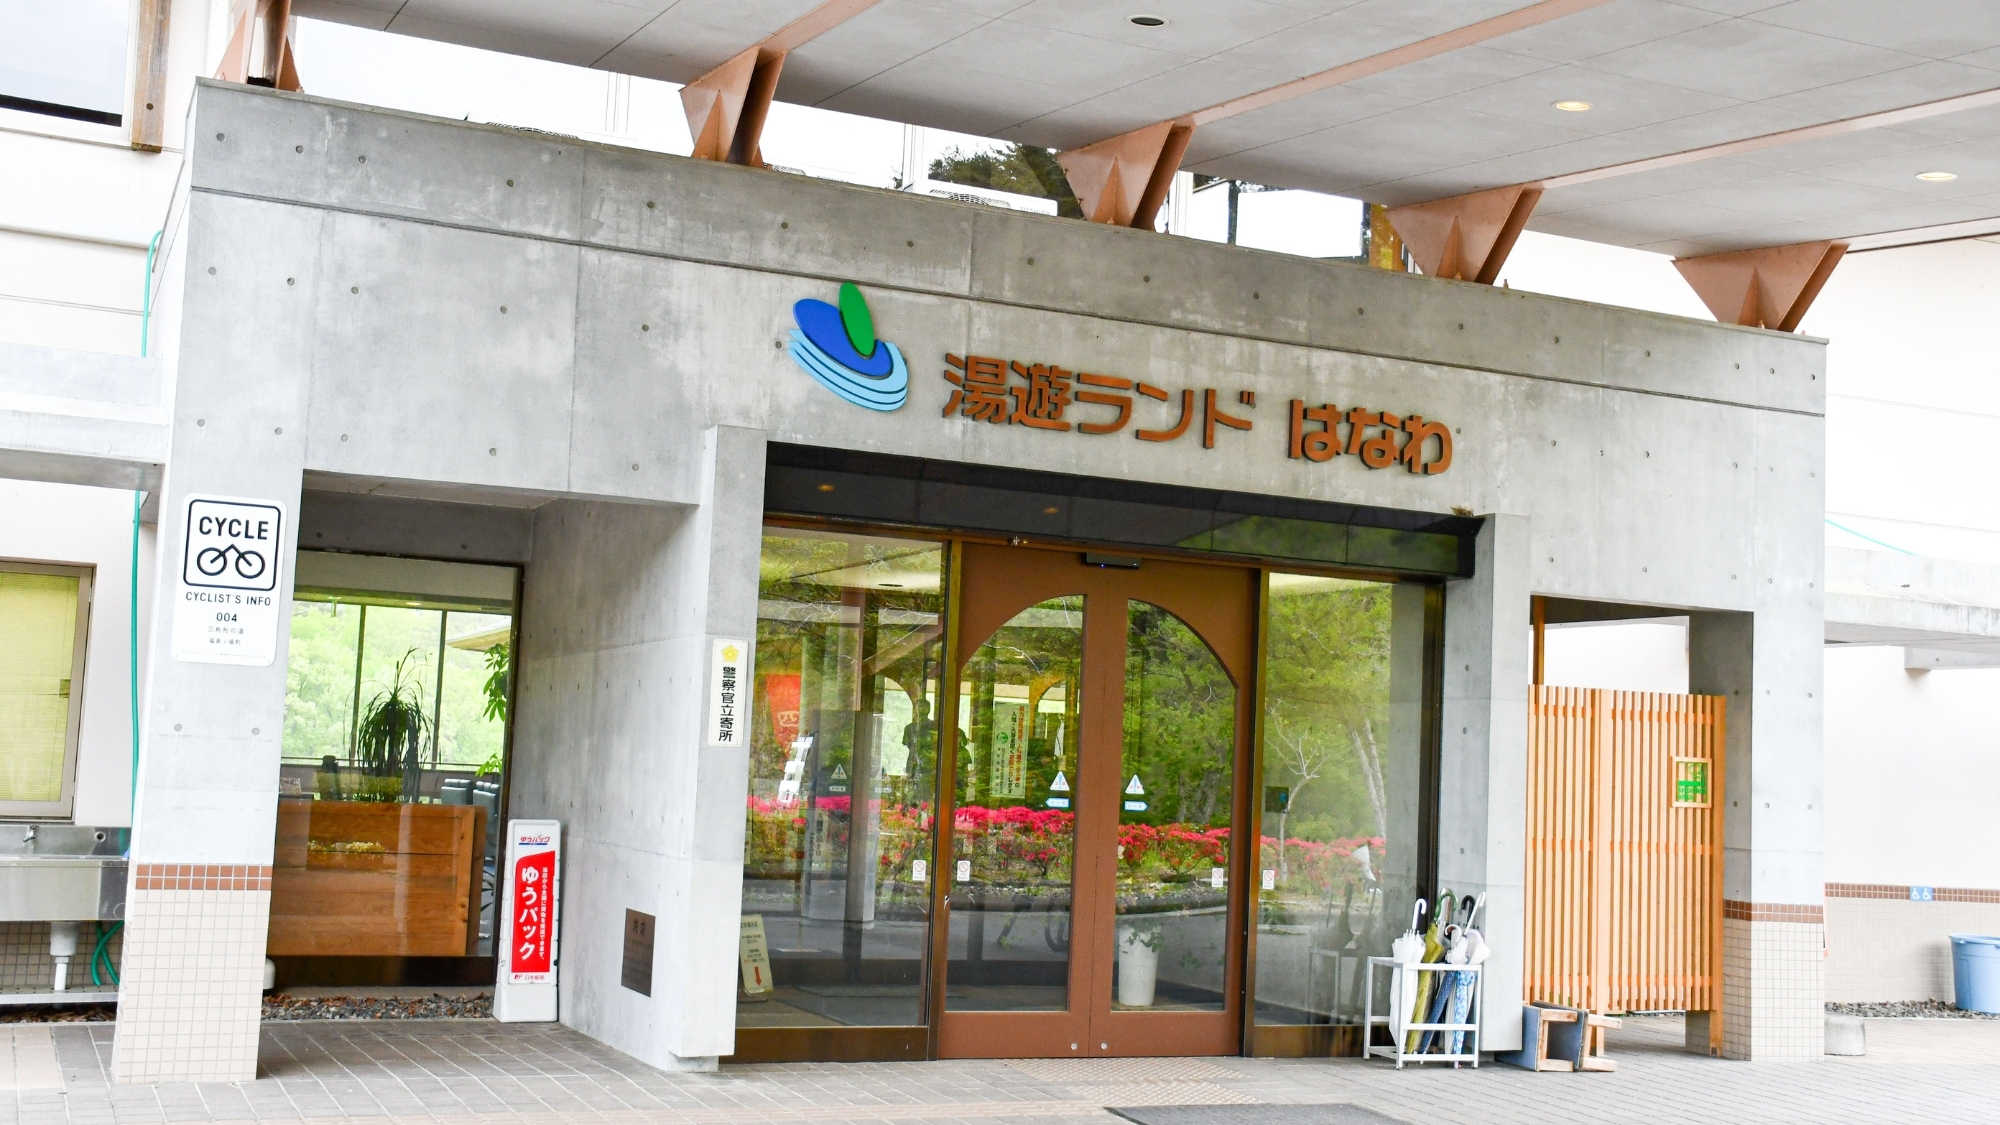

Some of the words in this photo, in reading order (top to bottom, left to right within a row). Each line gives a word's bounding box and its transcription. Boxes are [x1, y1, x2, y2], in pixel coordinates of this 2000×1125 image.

[942, 351, 1257, 450] 湯遊ランド
[1287, 398, 1454, 475] はなわ
[199, 516, 269, 540] CYCLE
[185, 591, 242, 604] CYCLIST'S
[246, 595, 271, 607] INFO
[216, 612, 237, 622] 004
[718, 666, 737, 742] 警察官立寄所
[520, 835, 551, 843] ゆうパック
[519, 866, 540, 960] ゆうパック
